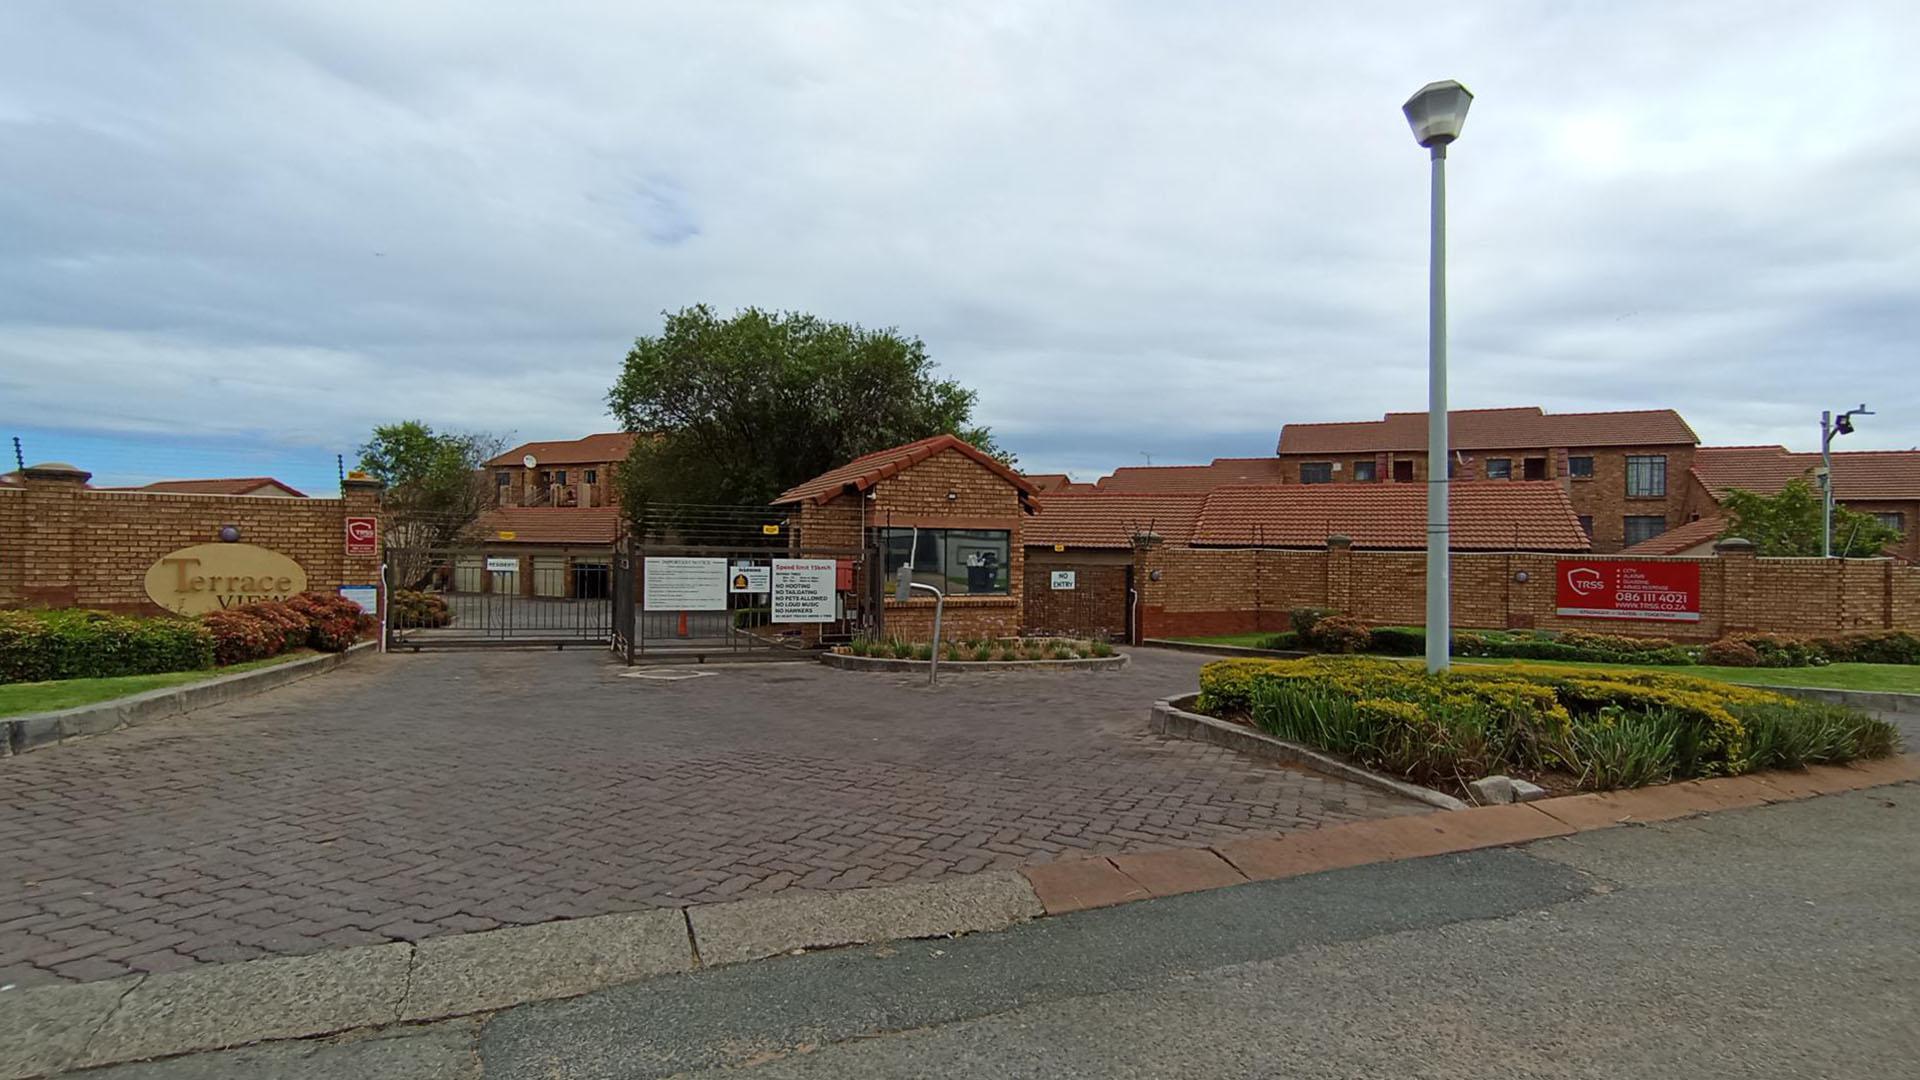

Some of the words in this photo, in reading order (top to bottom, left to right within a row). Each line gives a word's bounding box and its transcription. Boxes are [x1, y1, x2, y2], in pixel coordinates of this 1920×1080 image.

[162, 558, 292, 593] Terrace
[1576, 580, 1604, 590] TRSS
[1615, 592, 1640, 601] 086
[1643, 593, 1656, 602] 111
[1659, 594, 1688, 604] 4021
[1615, 602, 1687, 611] WWW.TRSS.CO.ZA
